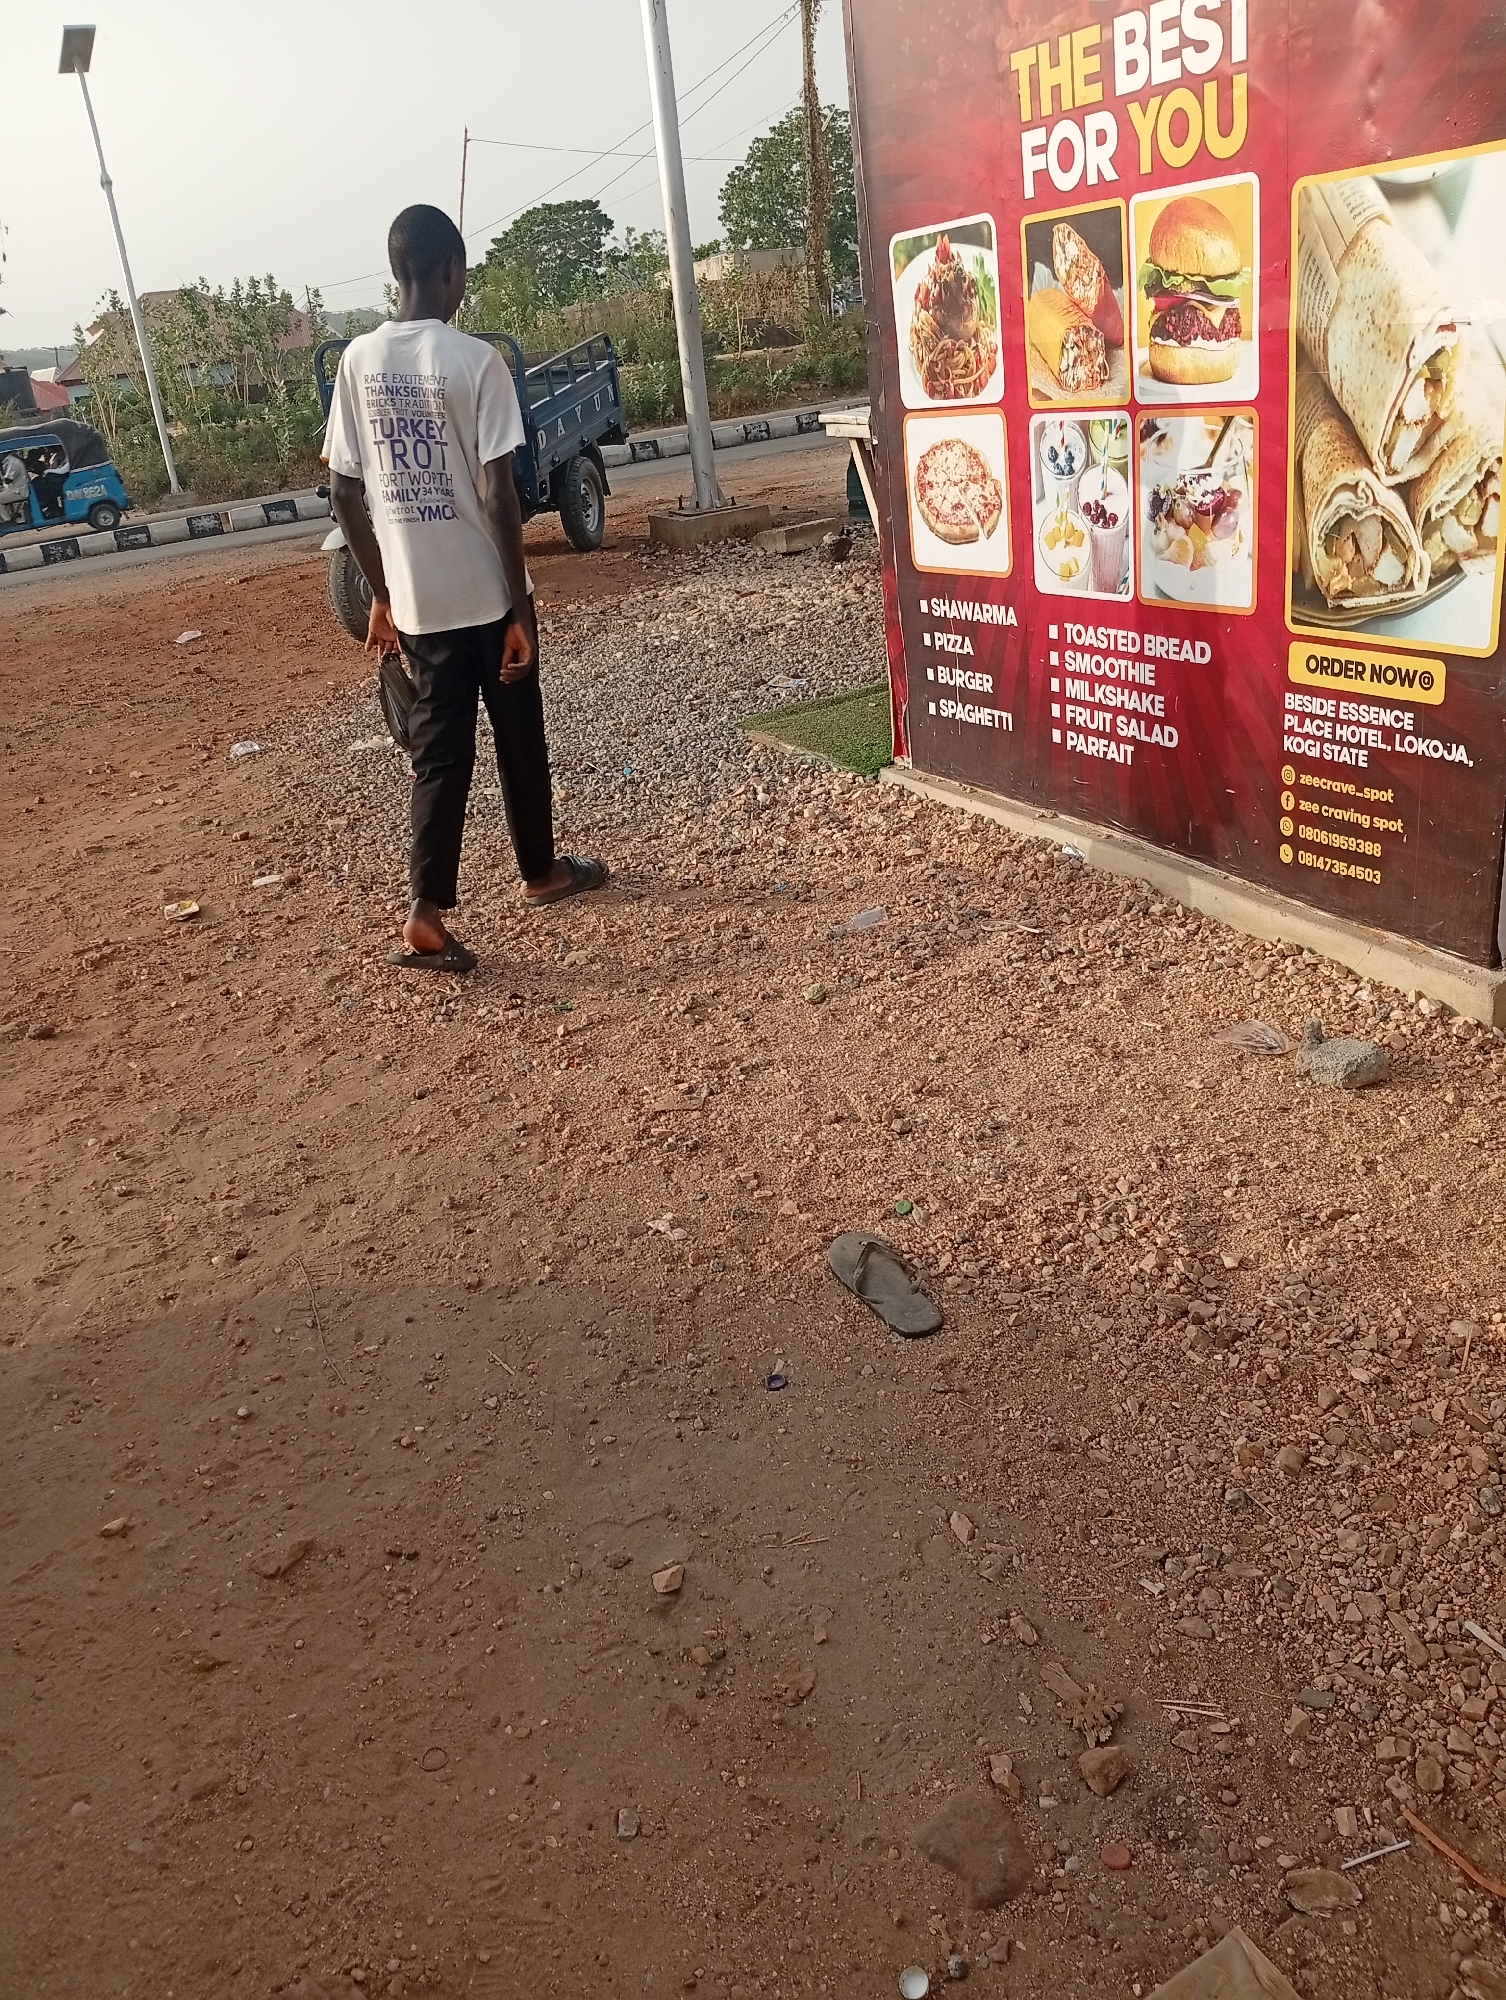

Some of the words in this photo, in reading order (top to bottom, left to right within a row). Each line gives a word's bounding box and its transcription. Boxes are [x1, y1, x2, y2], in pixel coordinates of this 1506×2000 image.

[1010, 23, 1103, 123] THE
[1113, 0, 1248, 97] BEST
[1021, 110, 1120, 200] FOR
[1126, 72, 1248, 175] YOU
[364, 373, 388, 385] RACE
[392, 374, 448, 387] EXCITEMENT
[364, 385, 446, 400] THANKSGIVING
[366, 398, 397, 409] BRICKS
[398, 398, 446, 411] TRADITION
[537, 383, 615, 450] DAYUN
[369, 417, 447, 440] TURKEY
[373, 438, 448, 472] TROT
[379, 472, 406, 488] FORT
[407, 470, 453, 488] WORTH
[382, 487, 421, 504] FAMILY
[422, 487, 433, 496] 34
[434, 487, 455, 498] YARS
[416, 504, 460, 522] YMCA
[931, 597, 1019, 627] SHAWARMA
[934, 631, 975, 656] PIZZA
[1064, 622, 1141, 654] TOASTED
[1143, 635, 1212, 665] BREAD
[937, 665, 993, 694] BURGER
[1064, 650, 1156, 687] SMOOTHIE
[1305, 654, 1367, 681] ORDER
[1065, 677, 1165, 718] MILKSHAKE
[1284, 692, 1336, 718] BESIDE
[1338, 701, 1415, 731] ESSENCE
[939, 699, 1014, 732] SPAGHETTI
[1066, 703, 1114, 734] FRUIT
[1116, 718, 1179, 749] SALAD
[1066, 730, 1135, 766] PARFAIT
[1283, 734, 1320, 758] KOGI
[1322, 743, 1369, 768] STATE
[1284, 713, 1333, 739] PLACE
[1335, 723, 1392, 752] HOTEL,
[1395, 733, 1474, 768] LOKOJA,
[1299, 772, 1395, 804] zeecrave_spot
[1298, 799, 1320, 814] zee
[1321, 805, 1371, 829] craving
[1372, 817, 1405, 834] spot
[1298, 824, 1382, 858] 08061959388
[1298, 850, 1382, 885] 08147354503
